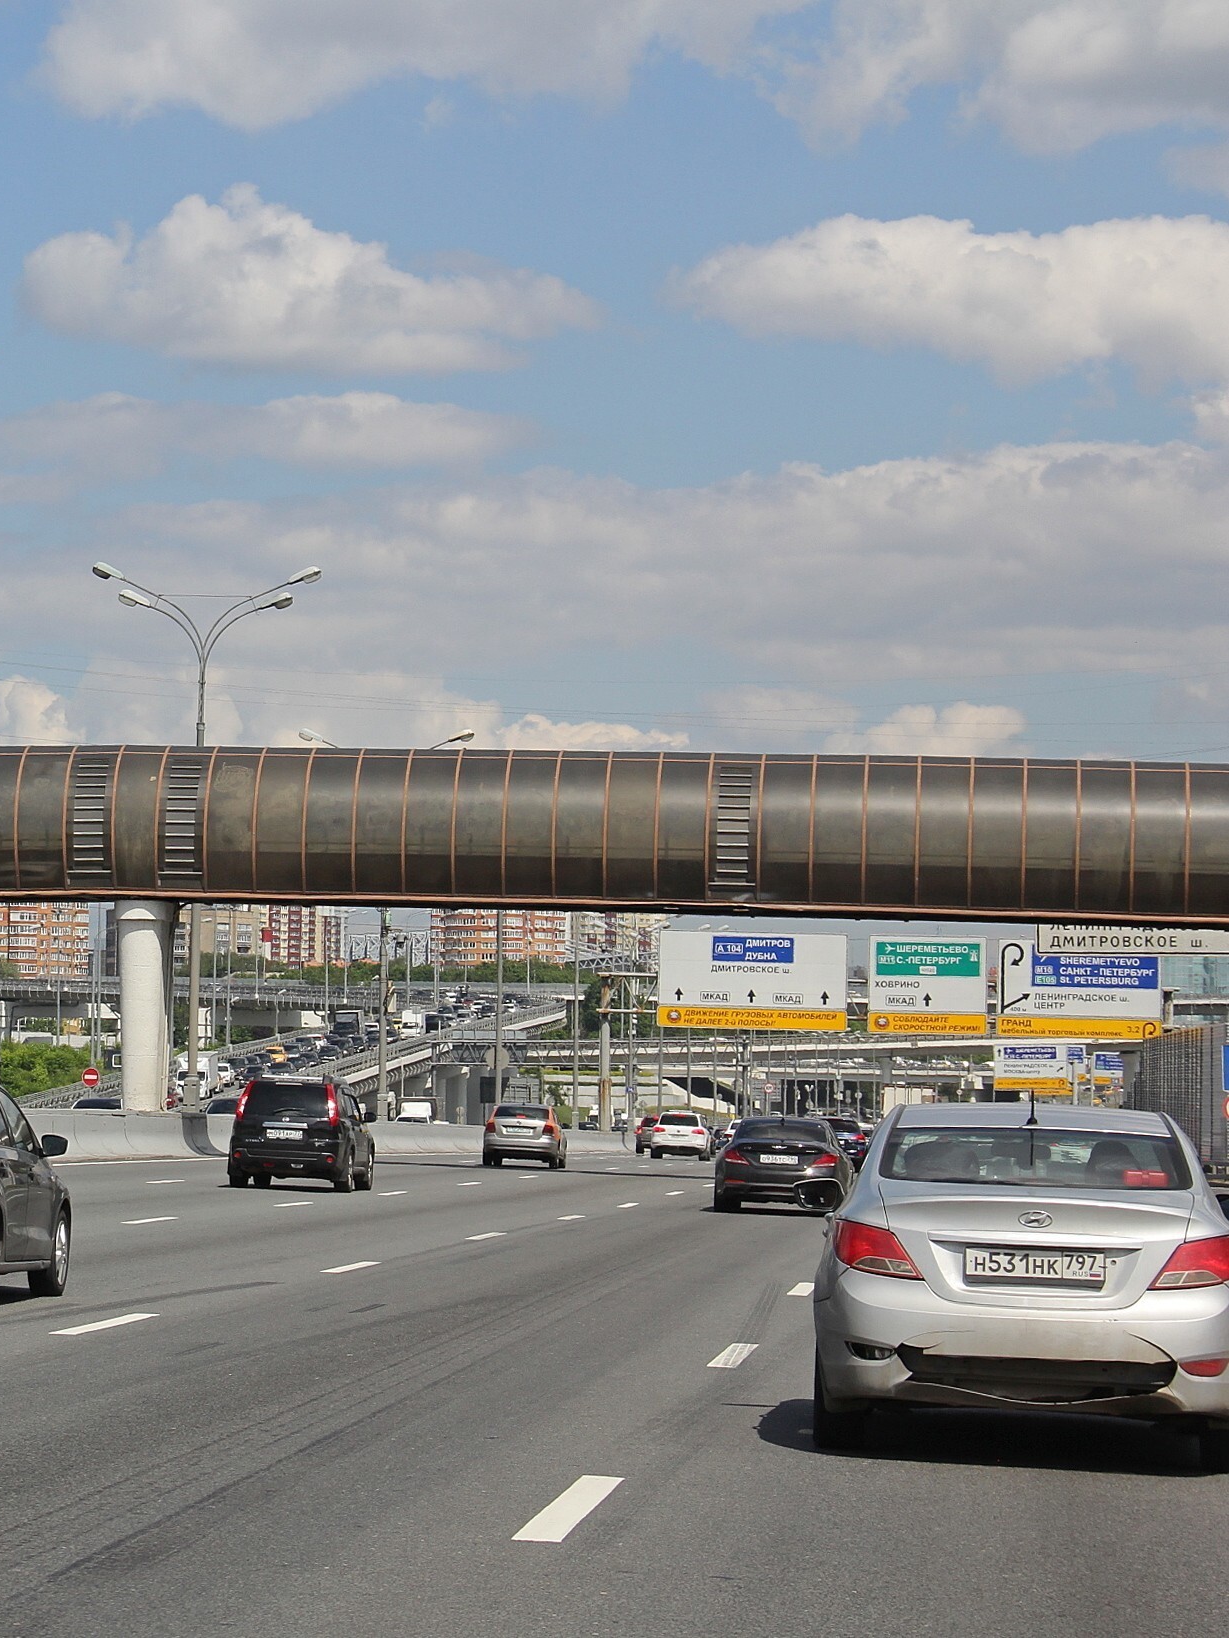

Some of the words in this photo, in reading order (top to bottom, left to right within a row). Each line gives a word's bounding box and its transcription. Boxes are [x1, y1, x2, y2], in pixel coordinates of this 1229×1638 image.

[745, 938, 791, 948] ДМИТРОВ
[1050, 935, 1177, 949] ДМИТРОВСКОЕ
[1190, 939, 1209, 948] ш.
[726, 944, 742, 953] 104
[896, 944, 969, 954] ШЕРЕМЕТЬЕВО
[745, 951, 777, 961] ДУБНА
[896, 955, 963, 965] С.-ПЕТЕРБУРГ
[711, 965, 779, 974] ДМИТРОВСКОЕ
[1059, 967, 1091, 975] САНКТ
[1099, 968, 1155, 977] ПЕТЕРБУРГ
[875, 980, 920, 989] ХОВРИНО
[1074, 976, 1139, 986] PETERSBURG
[702, 993, 729, 1002] МКАД
[775, 994, 802, 1004] МКАД
[887, 997, 915, 1005] МКАД
[1034, 992, 1117, 1002] ЛЕНИНГРАДСКОЕ
[1034, 1001, 1065, 1010] ЦЕНТР
[684, 1009, 729, 1018] ДВИЖЕНИЕ
[731, 1010, 774, 1019] ГРУЗОВЫХ
[777, 1011, 838, 1021] АВТОМОБИЛЕЙ
[893, 1015, 950, 1024] СОБЛЮДАЙТЕ
[683, 1017, 694, 1025] НЕ
[695, 1018, 722, 1026] ДАЛЕЕ
[1001, 1019, 1032, 1028] ГРАНД
[893, 1023, 947, 1031] СКОРОСТНОЙ
[1001, 1027, 1046, 1035] мебельный
[1048, 1028, 1085, 1037] торговый
[1064, 1254, 1097, 1270] 797
